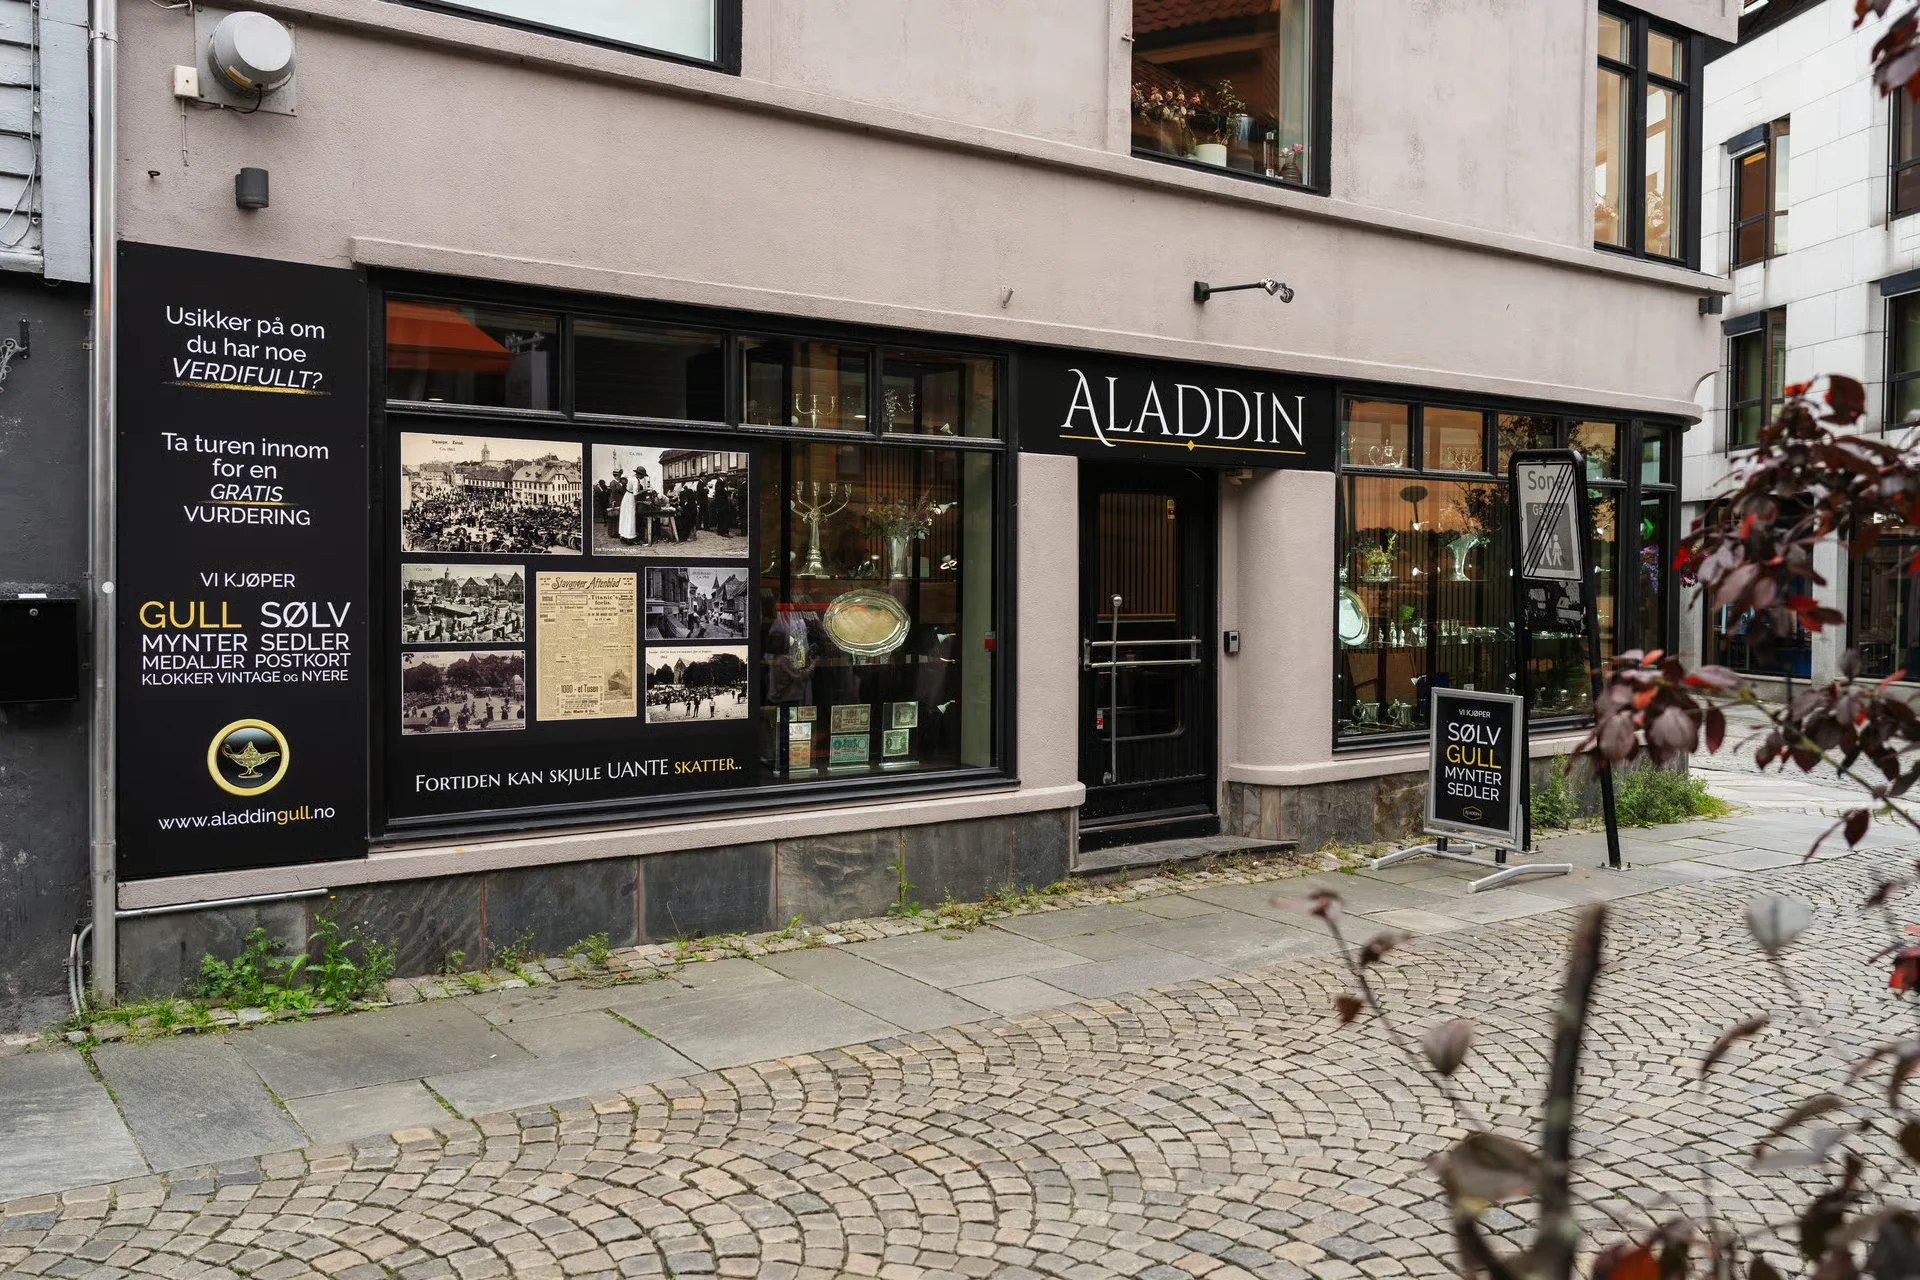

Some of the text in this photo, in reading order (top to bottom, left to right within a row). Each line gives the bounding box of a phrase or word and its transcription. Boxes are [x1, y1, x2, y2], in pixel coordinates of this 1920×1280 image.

[167, 306, 324, 339] Usikker på om
[187, 335, 306, 362] du har noe
[173, 358, 322, 389] VERDIFULLT?
[1060, 368, 1305, 447] ALADDIN
[161, 432, 328, 459] Ta turen innom
[213, 458, 276, 479] for en
[210, 483, 283, 502] GRATIS
[184, 504, 310, 525] VURDERING
[201, 573, 295, 587] VI KJØPER
[552, 577, 588, 590] Stavanger
[586, 577, 621, 589] Aftenblad
[140, 601, 350, 628] GULL SØLV
[143, 633, 349, 652] MYNTER SEDLER
[143, 653, 351, 670] MEDALJER POSTKORT
[143, 673, 213, 685] KLOKKER
[217, 671, 280, 683] VINTAGE
[302, 670, 348, 681] NYERE
[1458, 708, 1491, 718] VI KJØPER
[1447, 722, 1501, 746] SØLV
[1446, 744, 1501, 769] GULL
[416, 759, 741, 792] FORTIDEN KAN SKJULE UANTE SKATTER..
[1445, 765, 1501, 785] MYNTER
[1447, 782, 1500, 801] SEDLER
[159, 806, 335, 829] www.aladdingull.no
